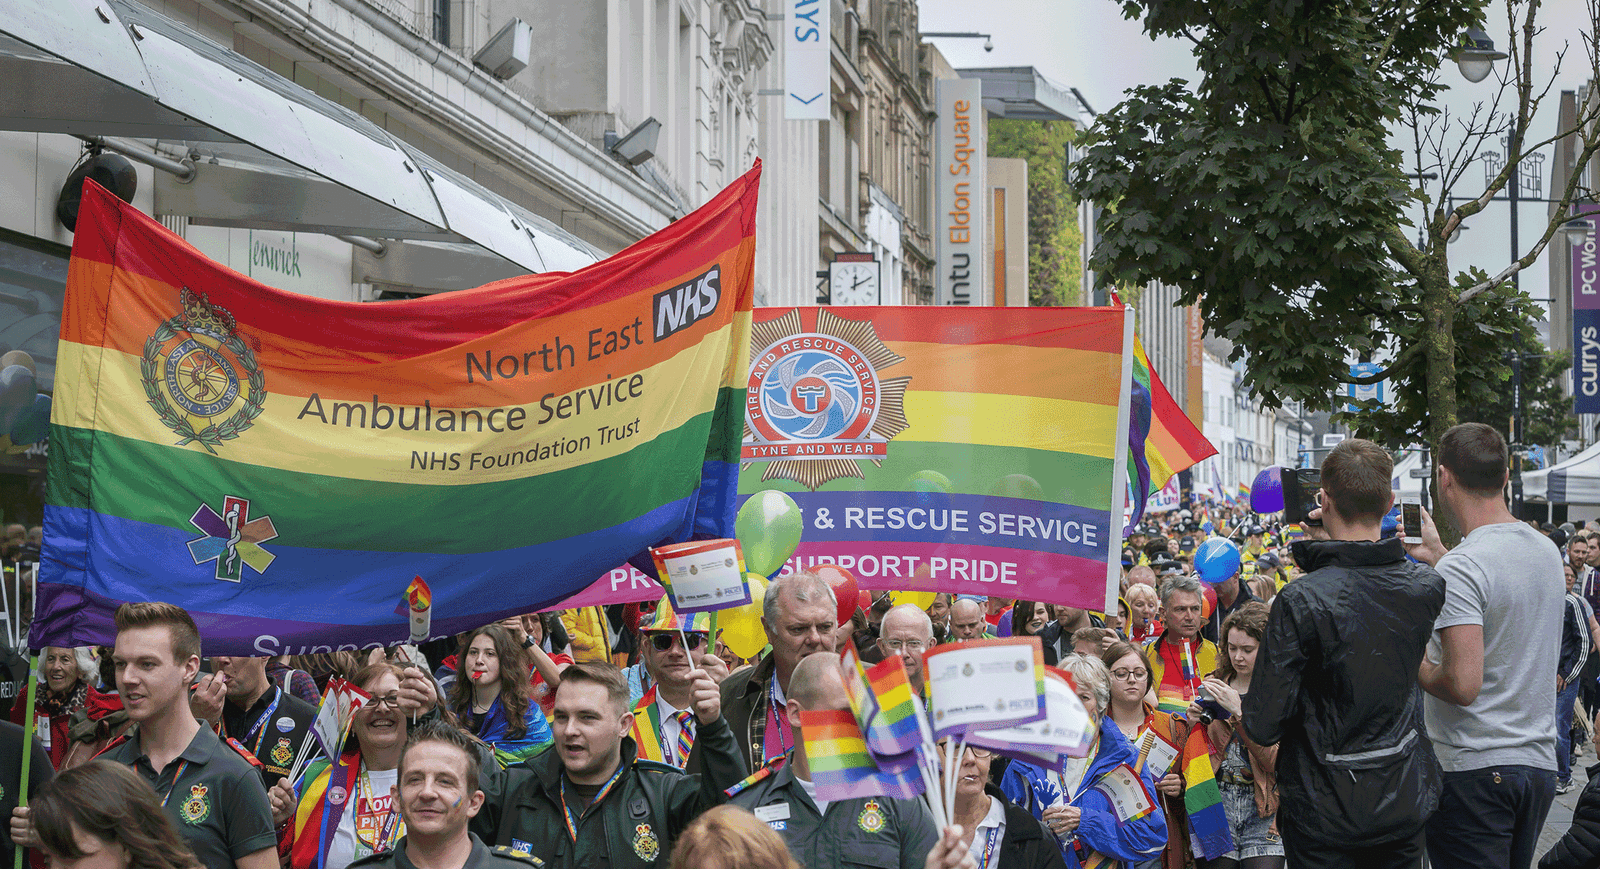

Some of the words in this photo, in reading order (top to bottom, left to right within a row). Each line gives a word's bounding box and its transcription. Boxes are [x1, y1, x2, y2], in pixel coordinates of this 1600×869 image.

[950, 99, 976, 176] Square
[949, 182, 971, 243] Eldon
[249, 229, 302, 278] enwick
[947, 253, 971, 305] intu
[1581, 270, 1597, 295] PC
[656, 270, 719, 338] NHS
[168, 346, 186, 372] EAST
[466, 336, 576, 384] North
[586, 316, 644, 362] East
[753, 353, 777, 380] AND
[780, 338, 846, 354] RESCUE
[167, 374, 194, 410] NORTH
[203, 381, 238, 414] SERVICE
[296, 392, 527, 434] Ambulance
[537, 373, 645, 425] Service
[748, 386, 762, 420] FIRE
[847, 354, 875, 415] SERVICE
[410, 450, 462, 471] NHS
[469, 434, 591, 471] Foundation
[597, 416, 642, 446] Trust
[751, 446, 789, 457] TYNE
[795, 444, 826, 454] AND
[831, 443, 875, 454] WEAR
[813, 507, 836, 530] &
[844, 506, 970, 533] RESCUE
[977, 511, 1099, 547] SERVICE
[930, 557, 1019, 586] PRIDE
